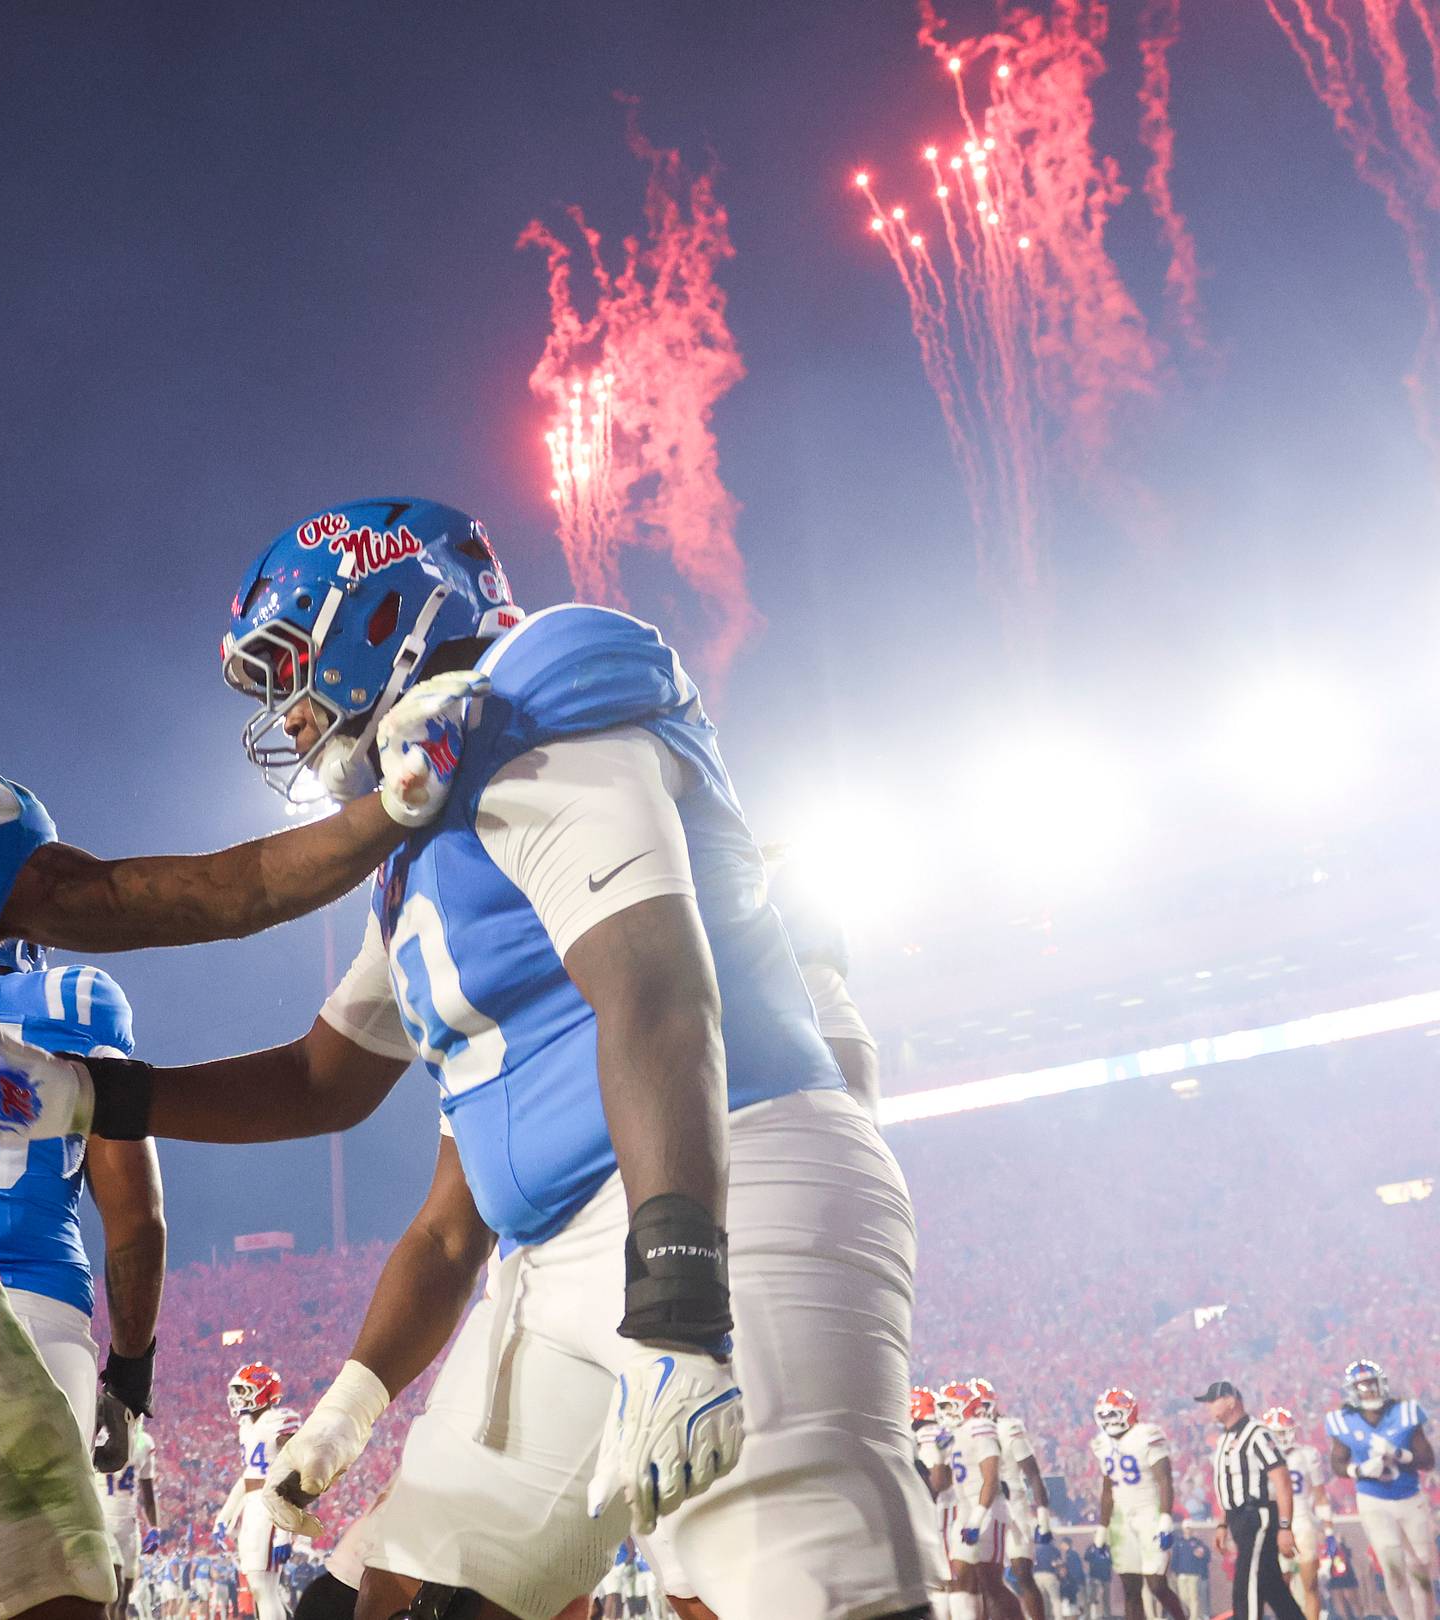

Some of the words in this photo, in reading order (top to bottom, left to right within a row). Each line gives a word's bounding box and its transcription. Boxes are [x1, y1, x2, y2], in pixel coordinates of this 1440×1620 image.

[298, 512, 349, 549] Ole
[329, 526, 422, 580] Miss
[646, 1245, 722, 1264] MUELLER
